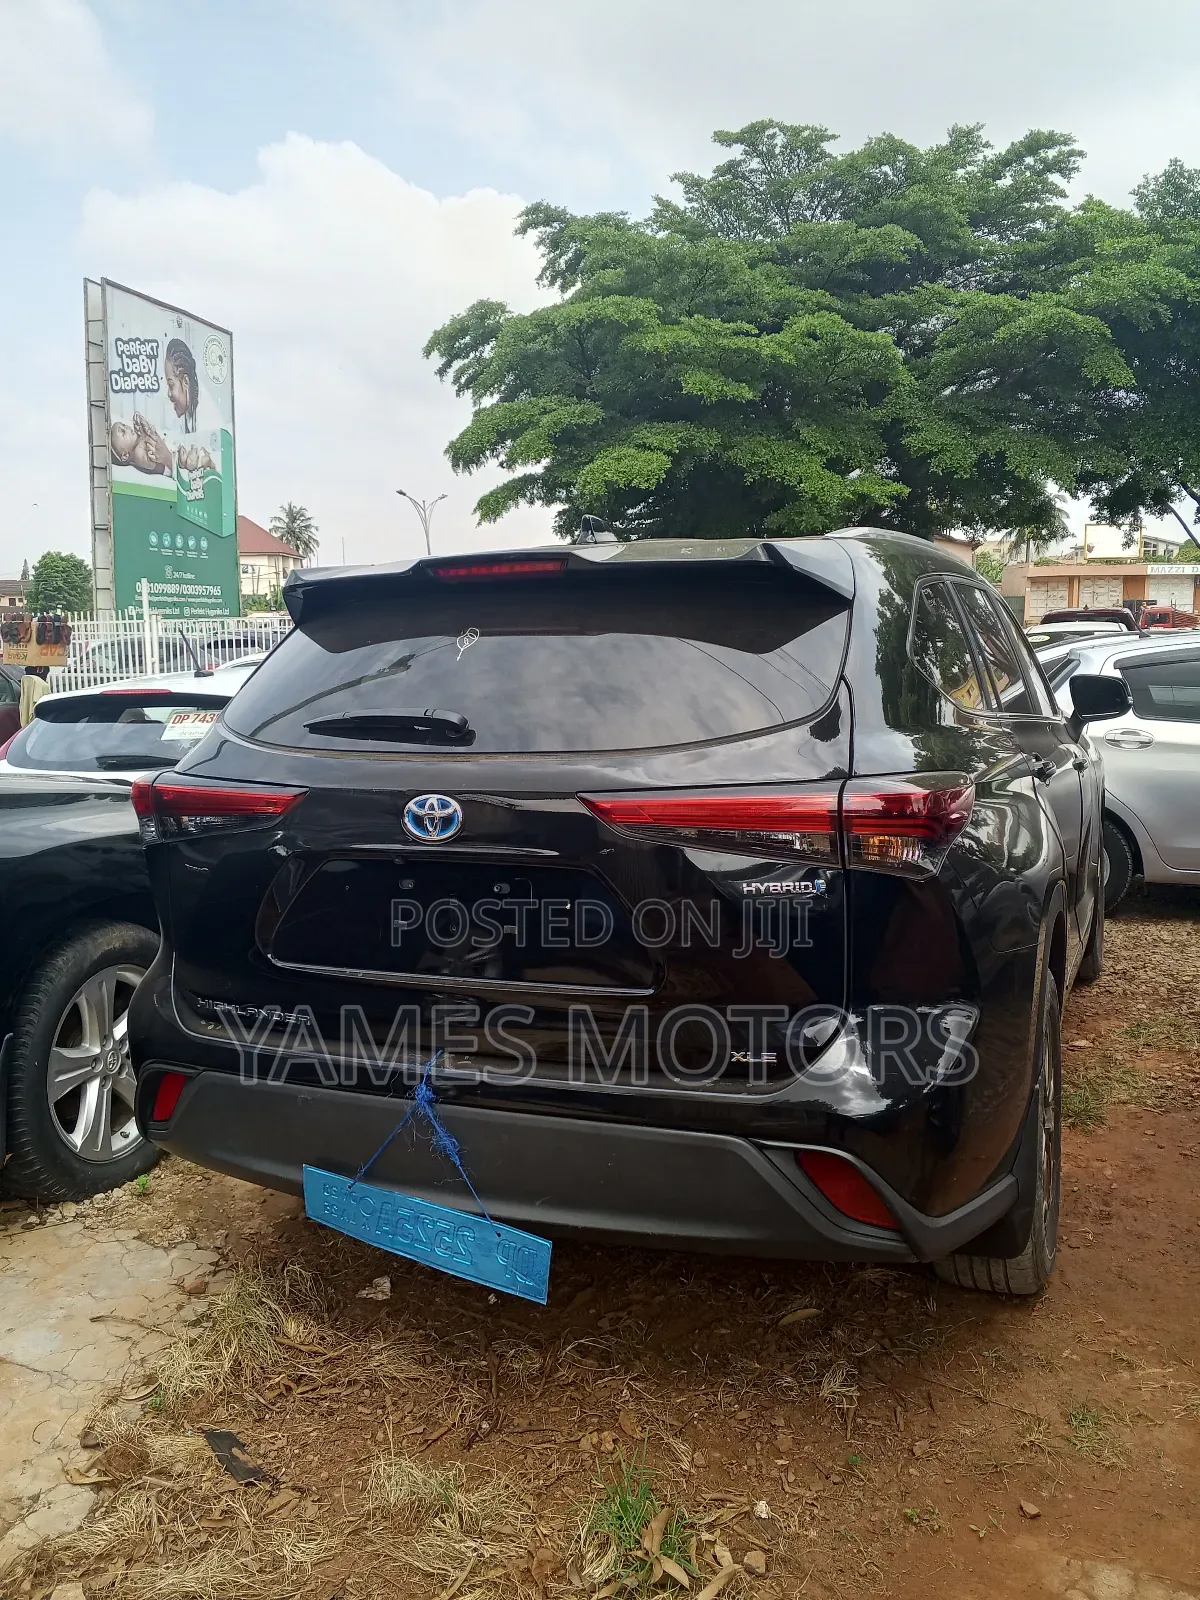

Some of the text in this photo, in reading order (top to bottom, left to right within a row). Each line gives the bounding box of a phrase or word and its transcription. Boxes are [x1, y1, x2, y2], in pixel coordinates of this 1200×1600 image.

[111, 372, 159, 390] DiaPeRs
[1150, 566, 1186, 574] MAZZI
[172, 714, 190, 724] DP
[742, 881, 813, 895] HYBRID
[197, 997, 311, 1026] HIGHLANDER
[730, 1051, 778, 1063] XLE
